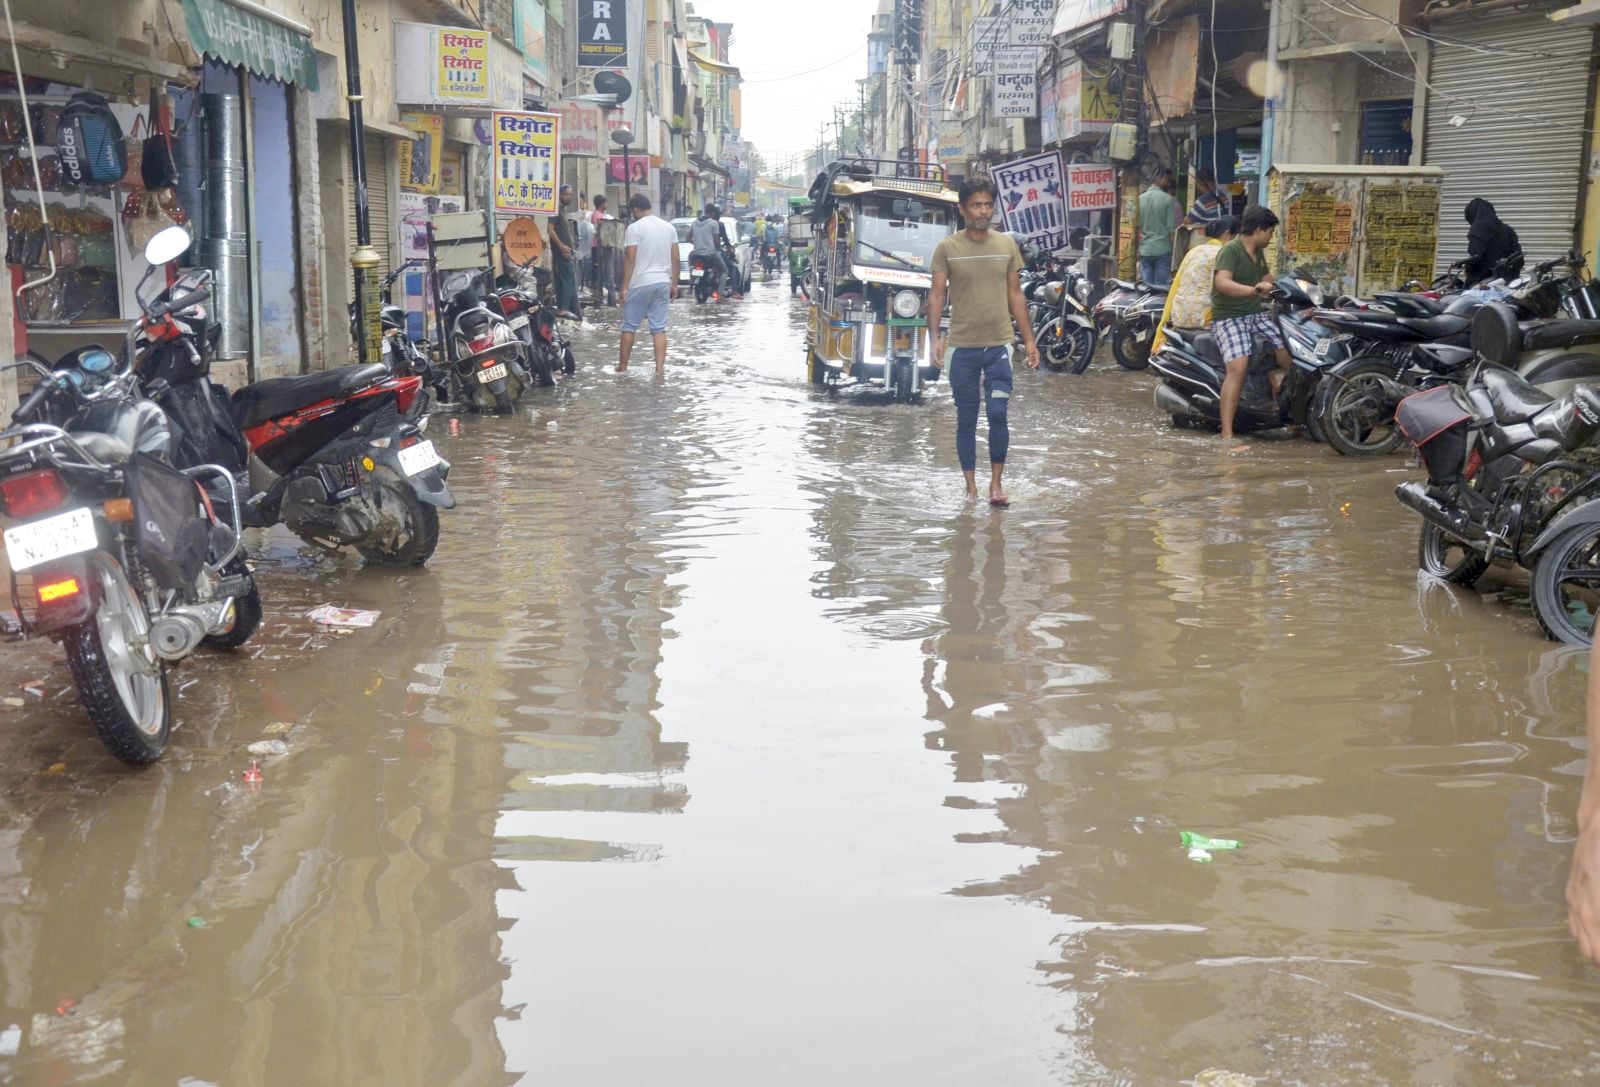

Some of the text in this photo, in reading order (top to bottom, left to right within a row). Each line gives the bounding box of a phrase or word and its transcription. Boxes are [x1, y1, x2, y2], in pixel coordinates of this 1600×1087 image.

[442, 33, 484, 49] रिमोट
[580, 44, 624, 53] Super Store
[442, 54, 484, 70] रिमोट
[997, 73, 1034, 92] बन्दूक
[997, 92, 1034, 100] मरम्मत
[499, 116, 554, 134] रिमोट
[61, 127, 82, 180] adidas
[499, 141, 553, 158] रिमोट
[1000, 162, 1055, 190] रिमोट
[498, 182, 553, 201] A.C. के रिमोट
[1026, 188, 1039, 202] ही
[10, 462, 33, 473] Hero
[328, 535, 341, 543] TVS
